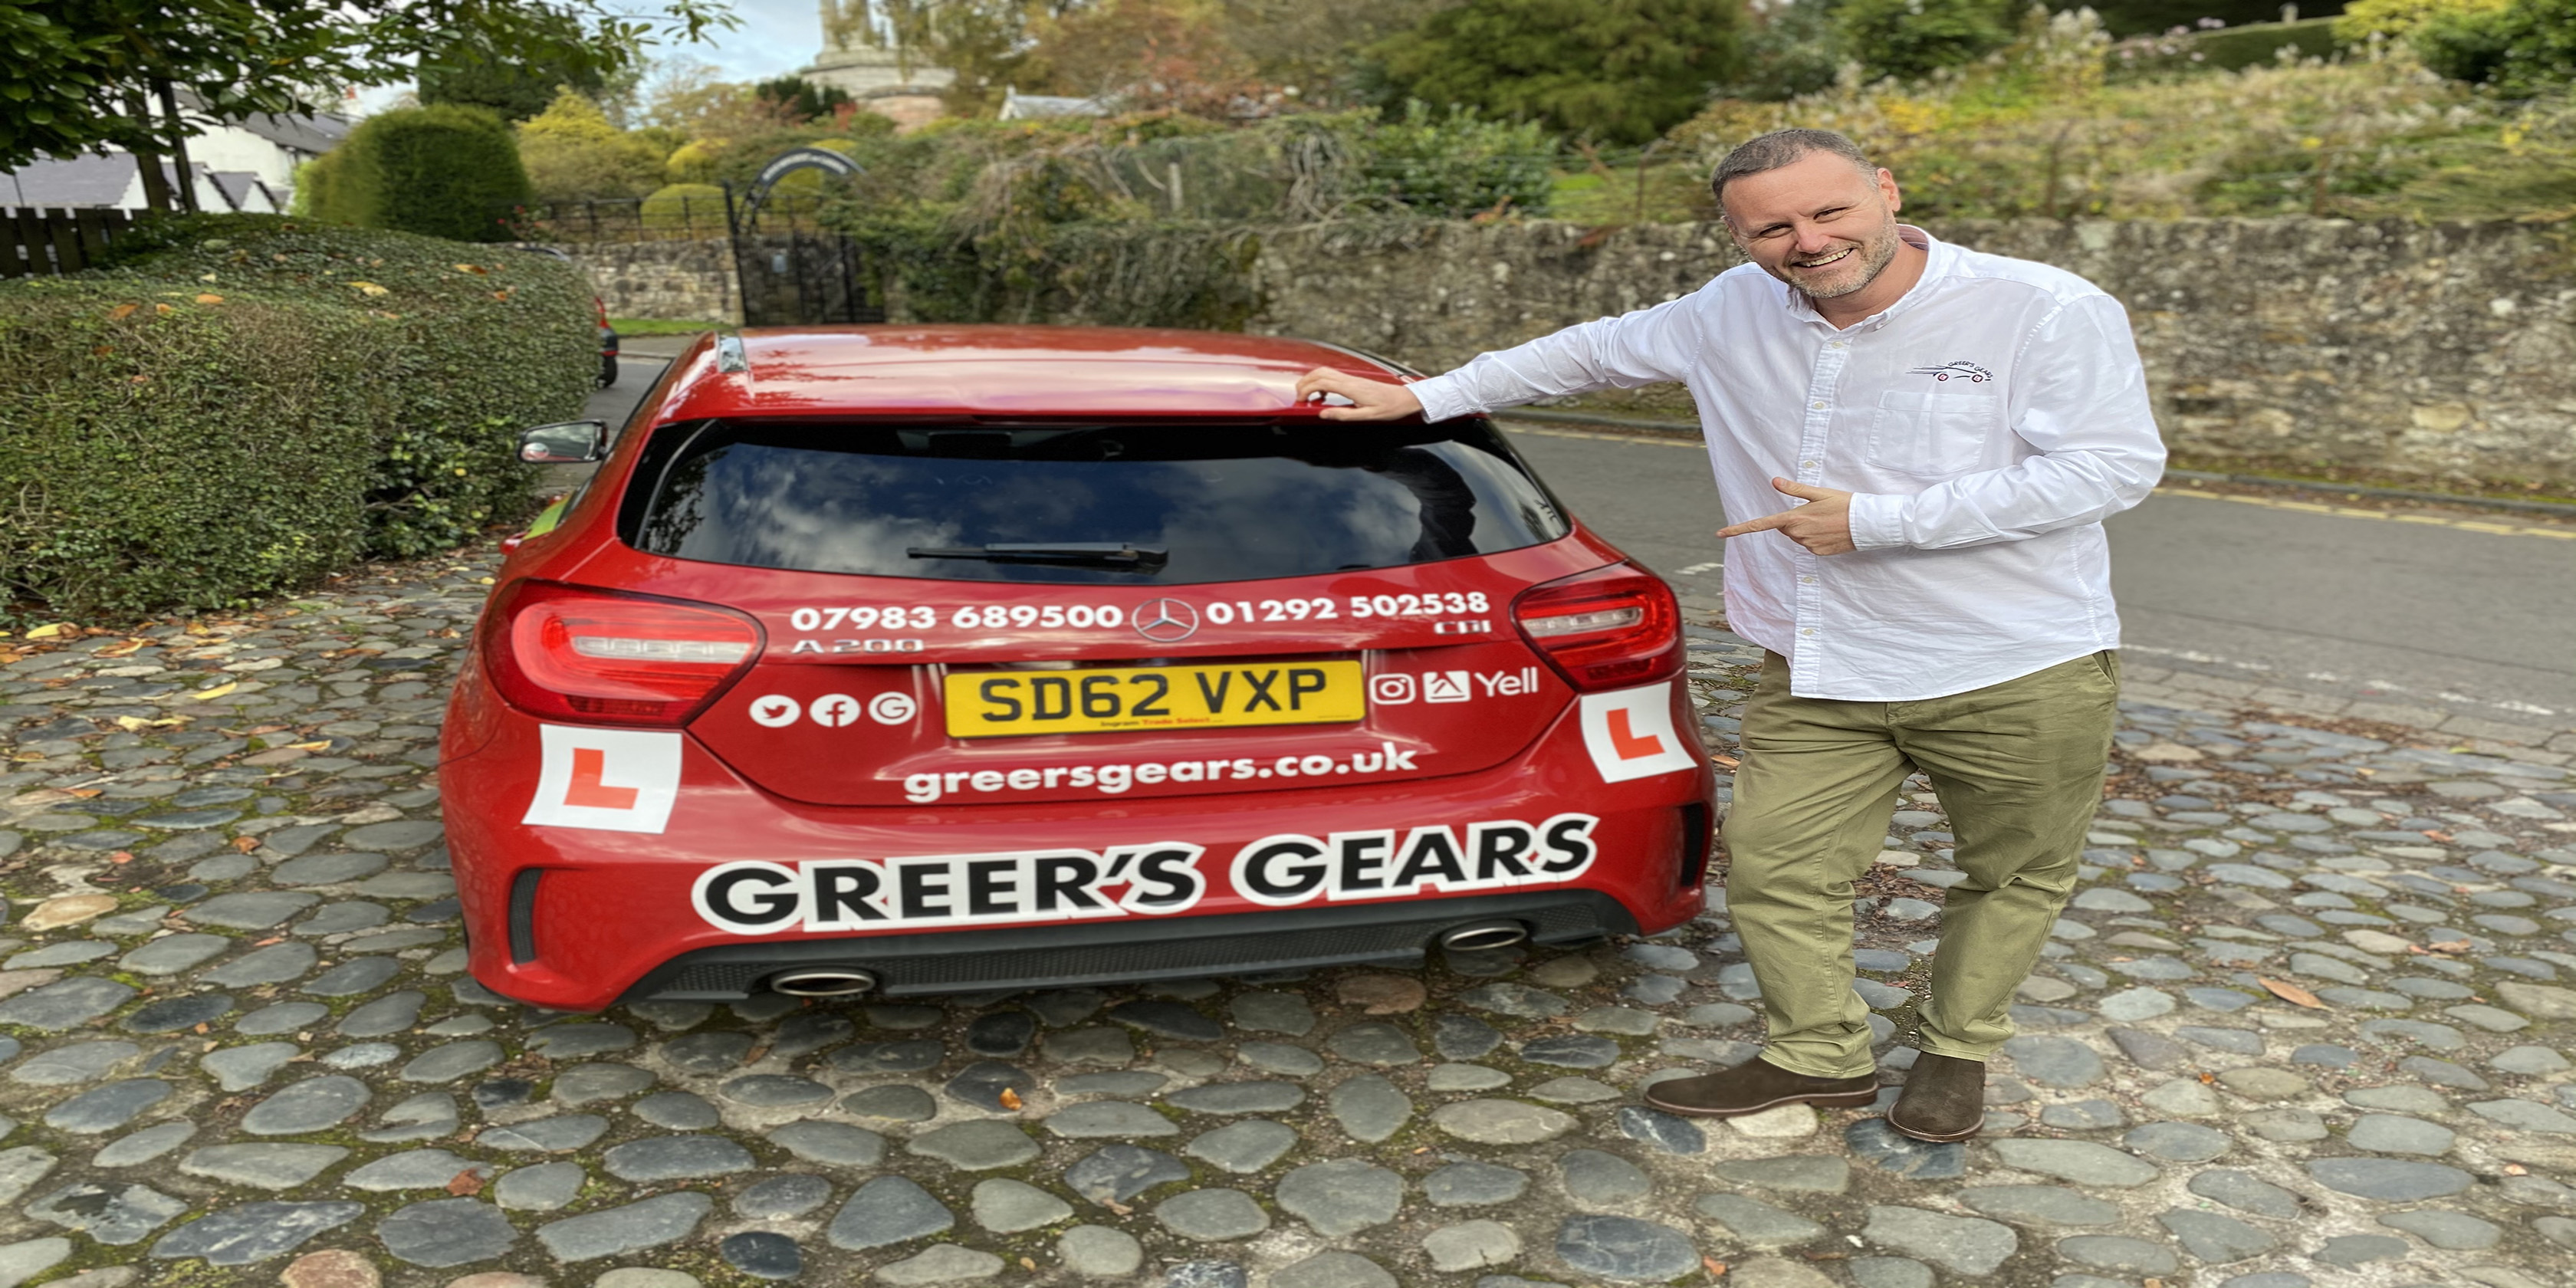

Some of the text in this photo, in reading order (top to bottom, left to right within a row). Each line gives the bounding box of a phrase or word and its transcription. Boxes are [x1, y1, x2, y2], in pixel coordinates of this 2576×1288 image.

[1973, 366, 1993, 378] GEARS
[790, 605, 1123, 631] 07983 689500
[1206, 592, 1490, 624] 01292 502538
[1433, 619, 1491, 635] CDI
[790, 639, 925, 653] A 200
[980, 668, 1326, 721] SD62 VXP
[1474, 666, 1538, 697] Yell
[1605, 707, 1666, 761] L
[563, 747, 640, 810] L
[904, 742, 1418, 803] greersgears.co.uk
[702, 817, 1593, 928] GREER'S GEARS
